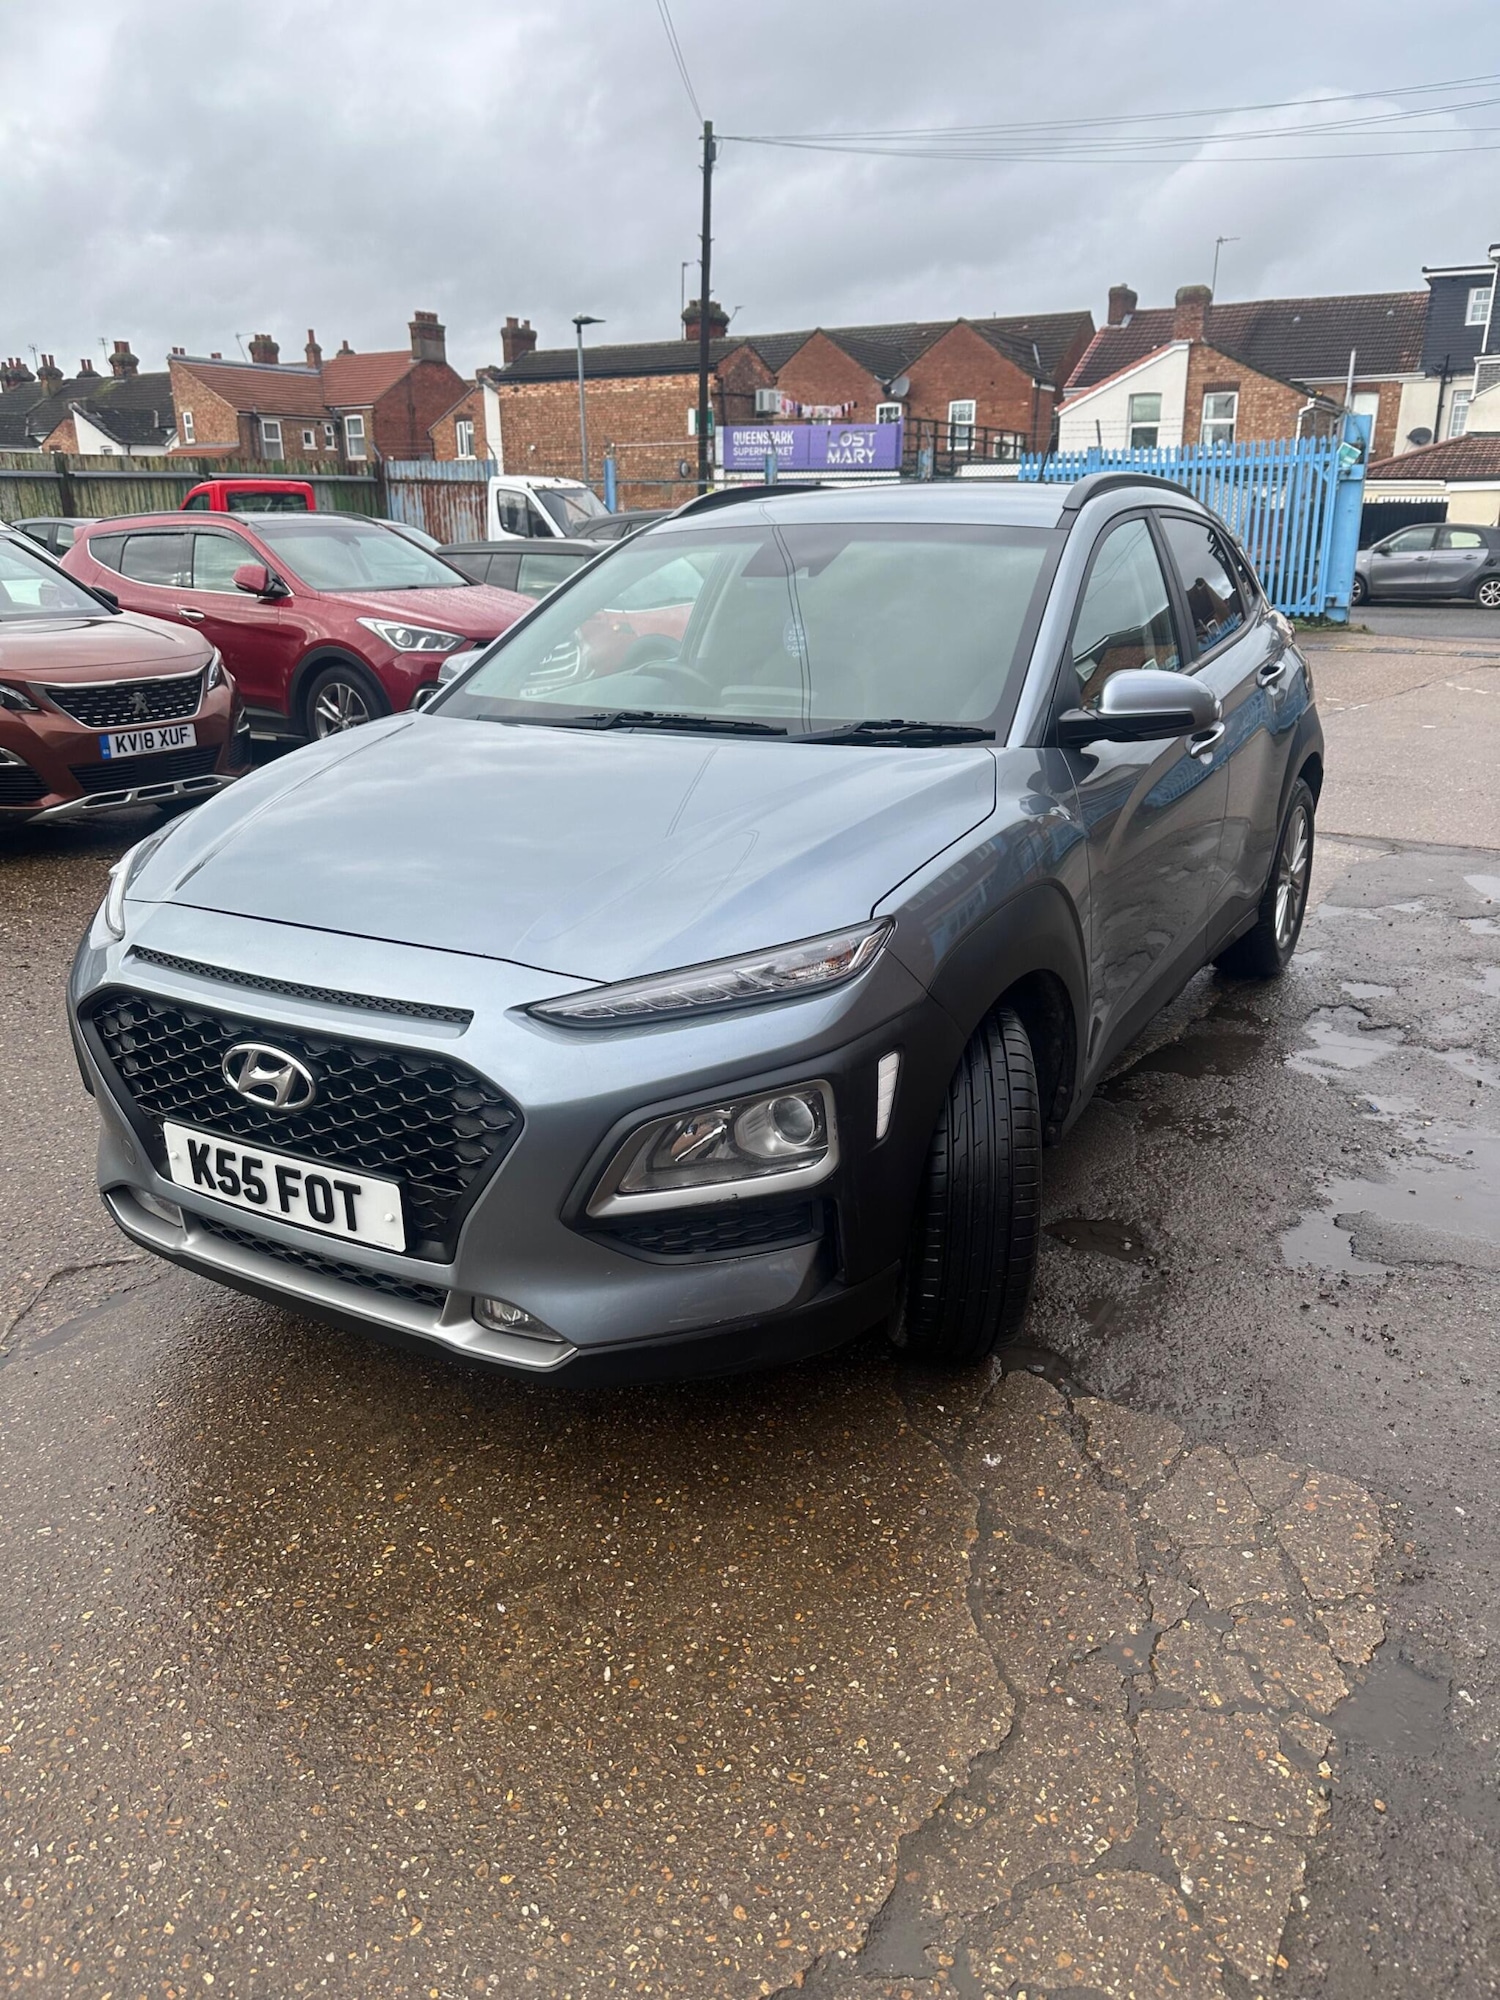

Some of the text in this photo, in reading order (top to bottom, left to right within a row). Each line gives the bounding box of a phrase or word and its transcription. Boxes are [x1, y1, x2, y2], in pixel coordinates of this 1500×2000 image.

[733, 431, 794, 446] QUEENSPARK
[827, 430, 877, 447] LOST
[733, 446, 794, 456] SUPERMAKET
[827, 448, 876, 464] MARY
[115, 726, 188, 753] KV18 XUF
[187, 1138, 362, 1232] K55 FOT
